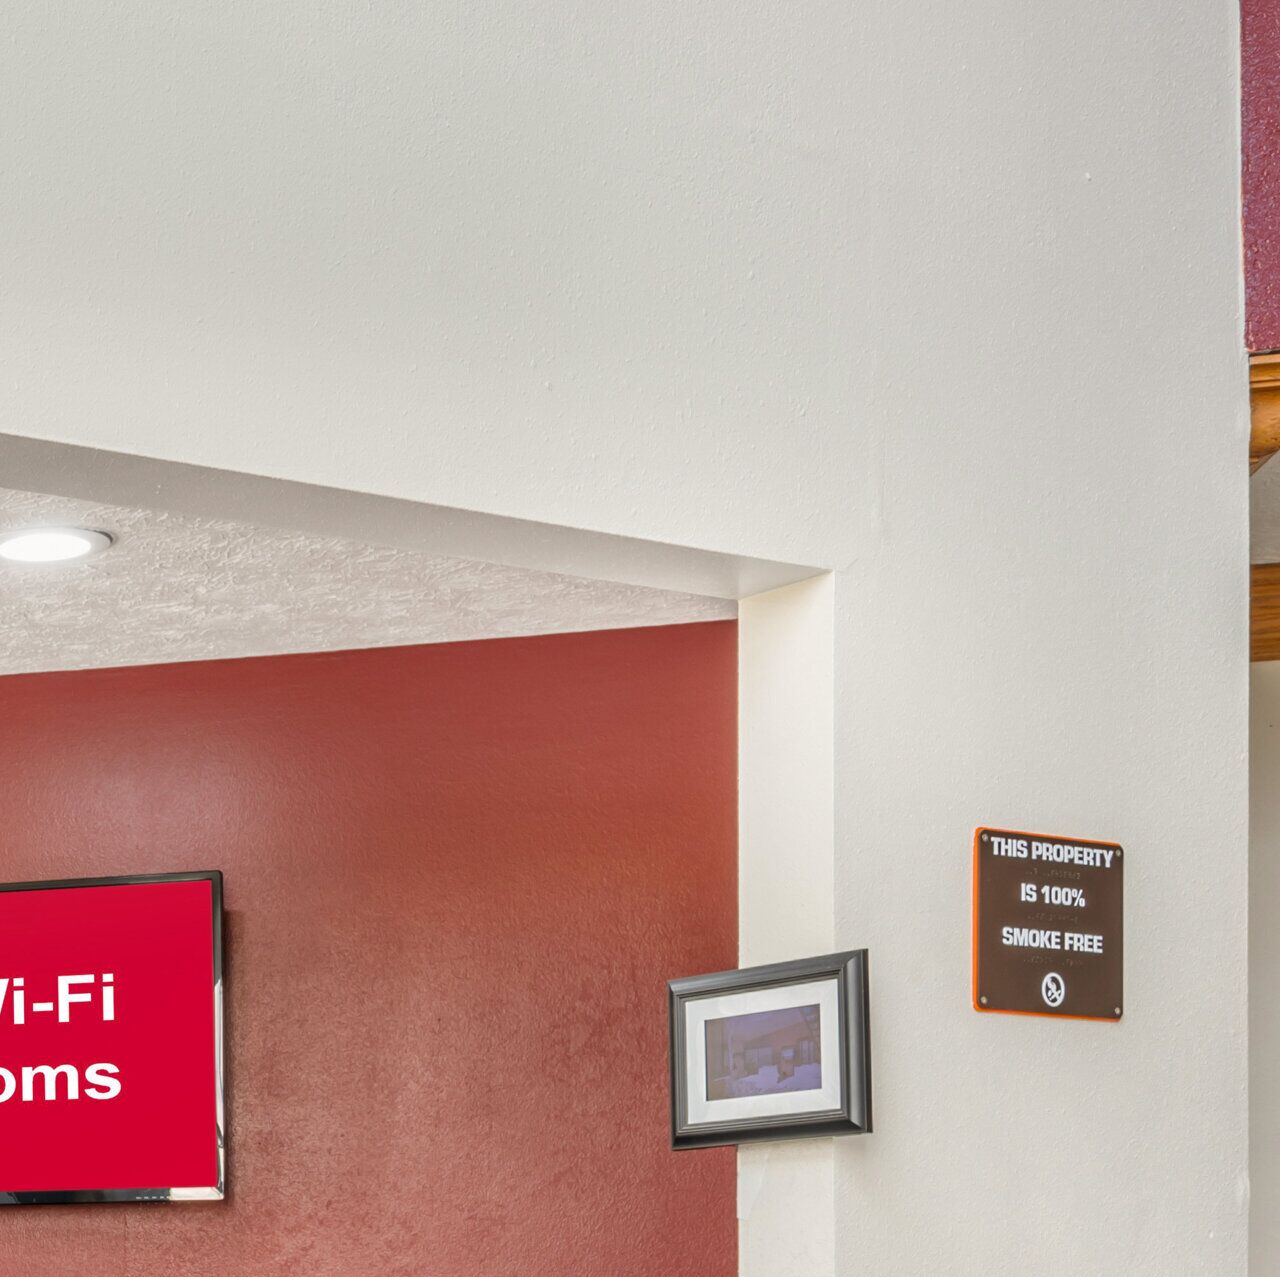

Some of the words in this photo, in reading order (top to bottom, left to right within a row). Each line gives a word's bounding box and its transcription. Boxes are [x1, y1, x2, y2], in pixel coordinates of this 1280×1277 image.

[990, 836, 1028, 860] THIS
[1031, 840, 1114, 868] PROPERTY
[1020, 883, 1037, 902] IS
[1040, 885, 1086, 907] 100%
[1001, 926, 1061, 950] SMOKE
[1064, 933, 1103, 954] FREE
